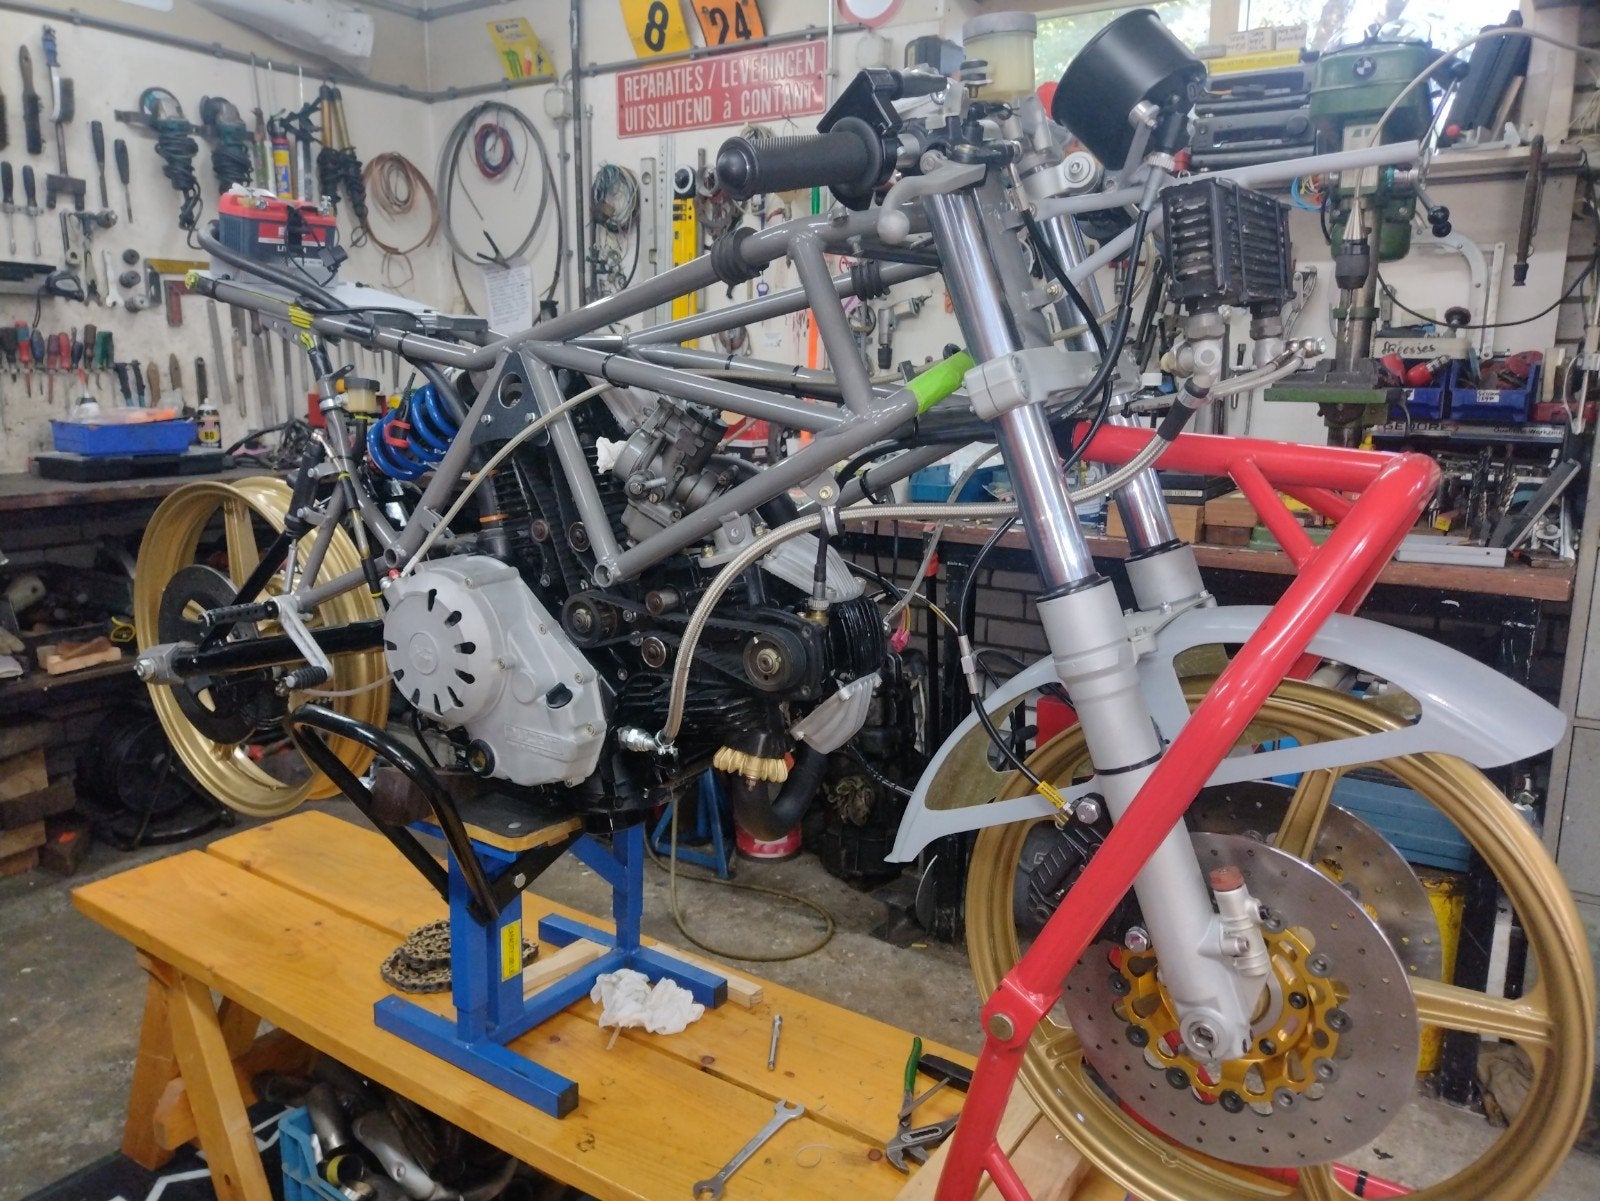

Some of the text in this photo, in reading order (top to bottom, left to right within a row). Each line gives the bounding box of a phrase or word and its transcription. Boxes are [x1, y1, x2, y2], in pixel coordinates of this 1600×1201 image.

[644, 1, 669, 52] 8
[708, 2, 752, 45] 24
[624, 46, 816, 102] REPARATIES / LEVERINGEN
[624, 81, 814, 132] UITSLUITEND à CONTANT
